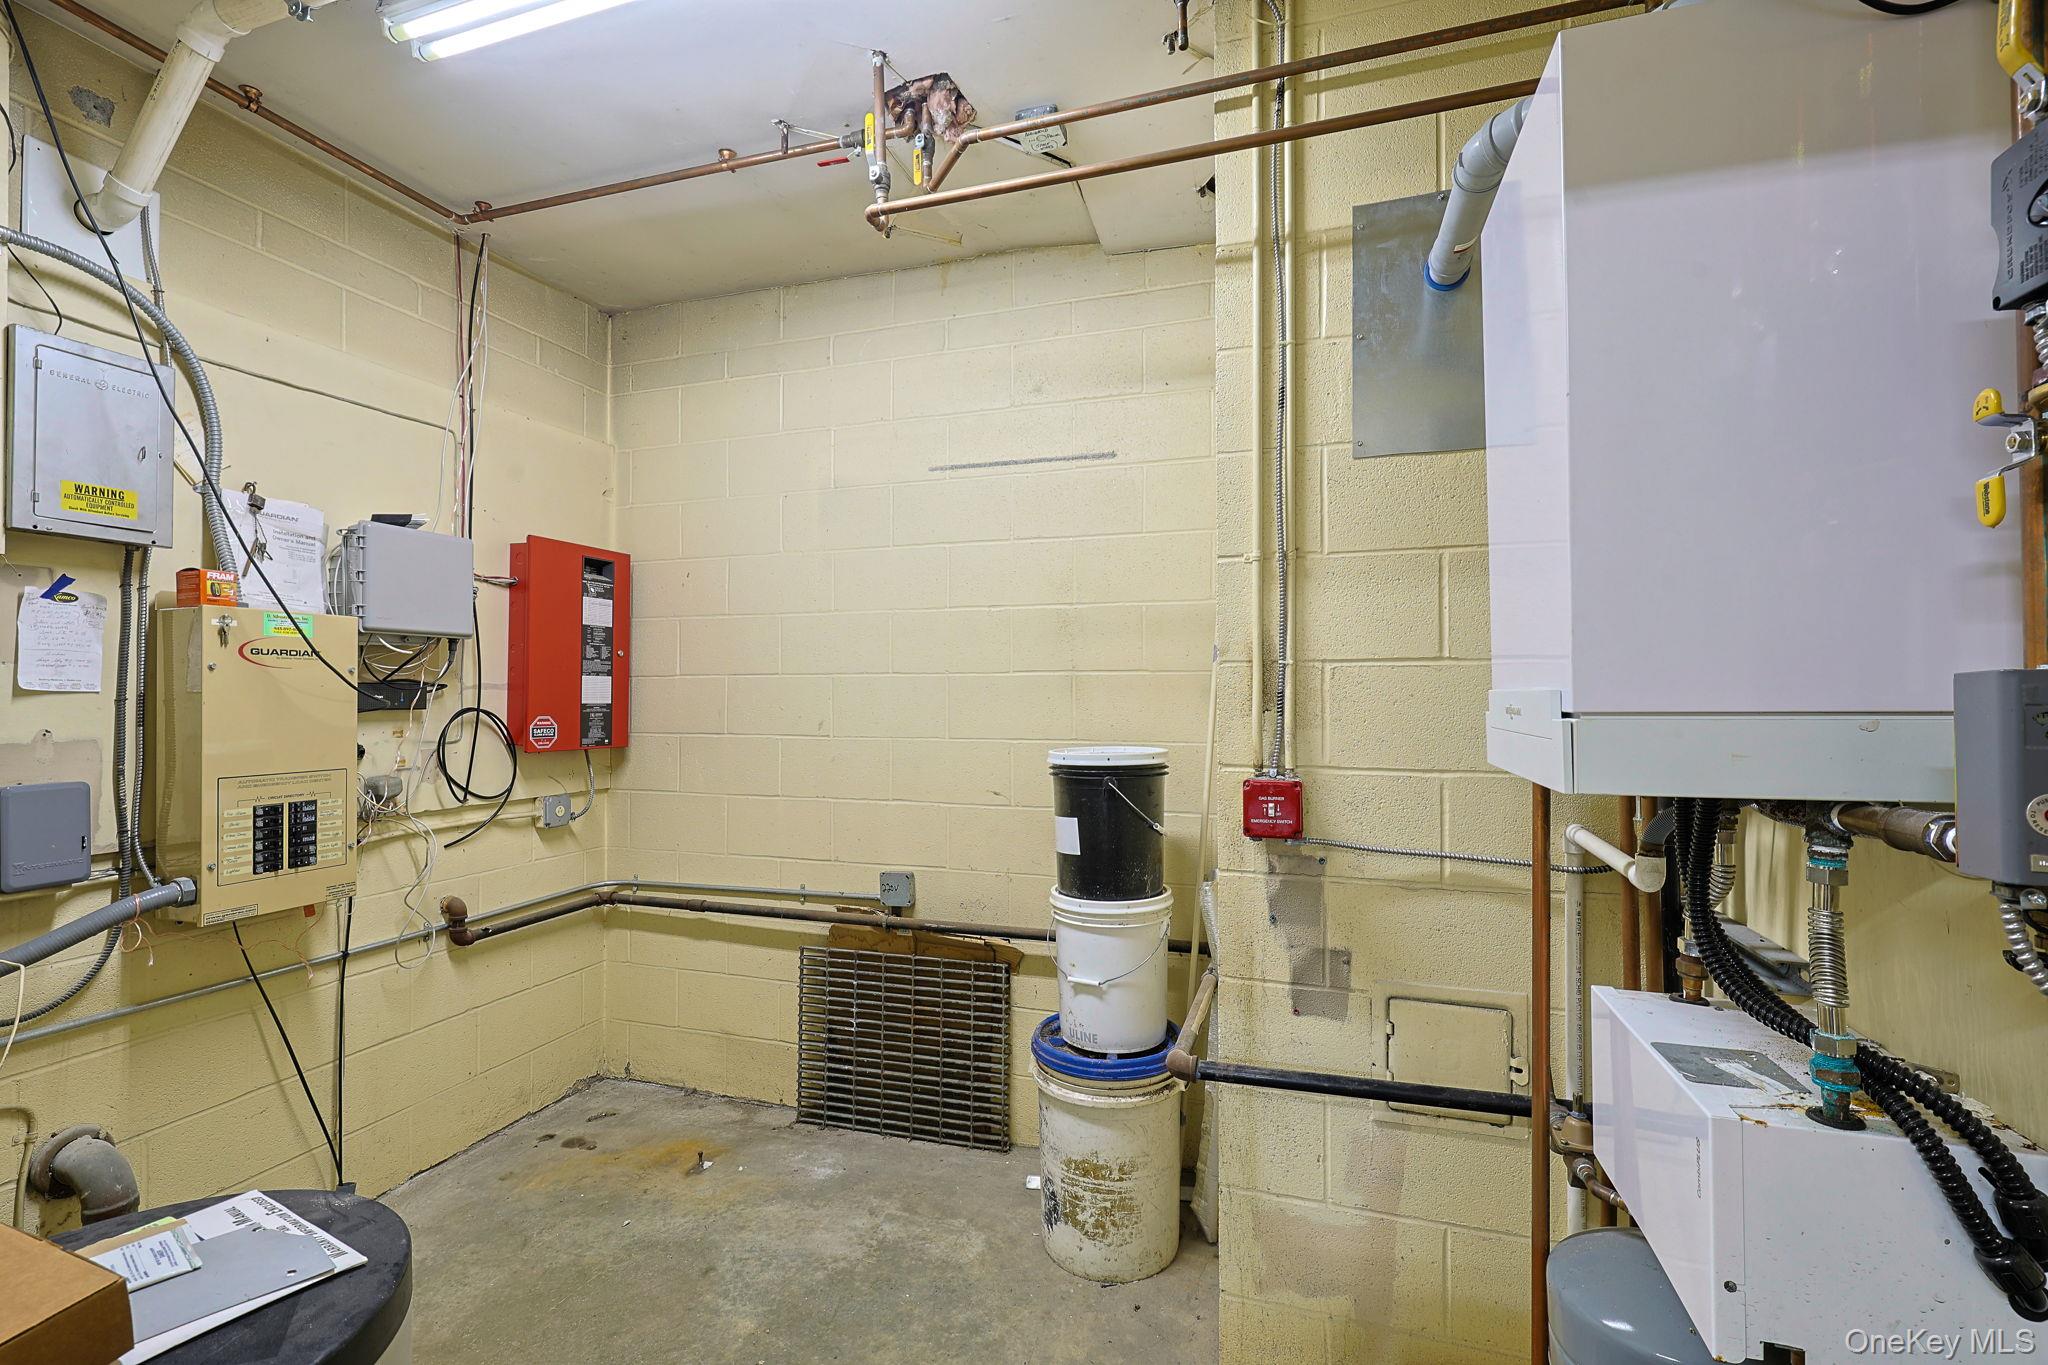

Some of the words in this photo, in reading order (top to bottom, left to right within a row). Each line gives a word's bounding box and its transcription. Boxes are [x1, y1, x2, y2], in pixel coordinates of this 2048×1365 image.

[50, 369, 91, 385] GENERAL
[112, 384, 150, 399] ELECTRIC
[74, 483, 125, 500] WARNING
[64, 493, 104, 505] AUTOMATICALLY
[105, 500, 135, 509] CONTROLLED
[86, 502, 114, 512] EQUIPMENT
[259, 511, 300, 523] UARDIAN
[207, 571, 235, 581] FRAM
[1069, 1027, 1098, 1045] ULINE
[224, 1205, 254, 1227] MANUAL
